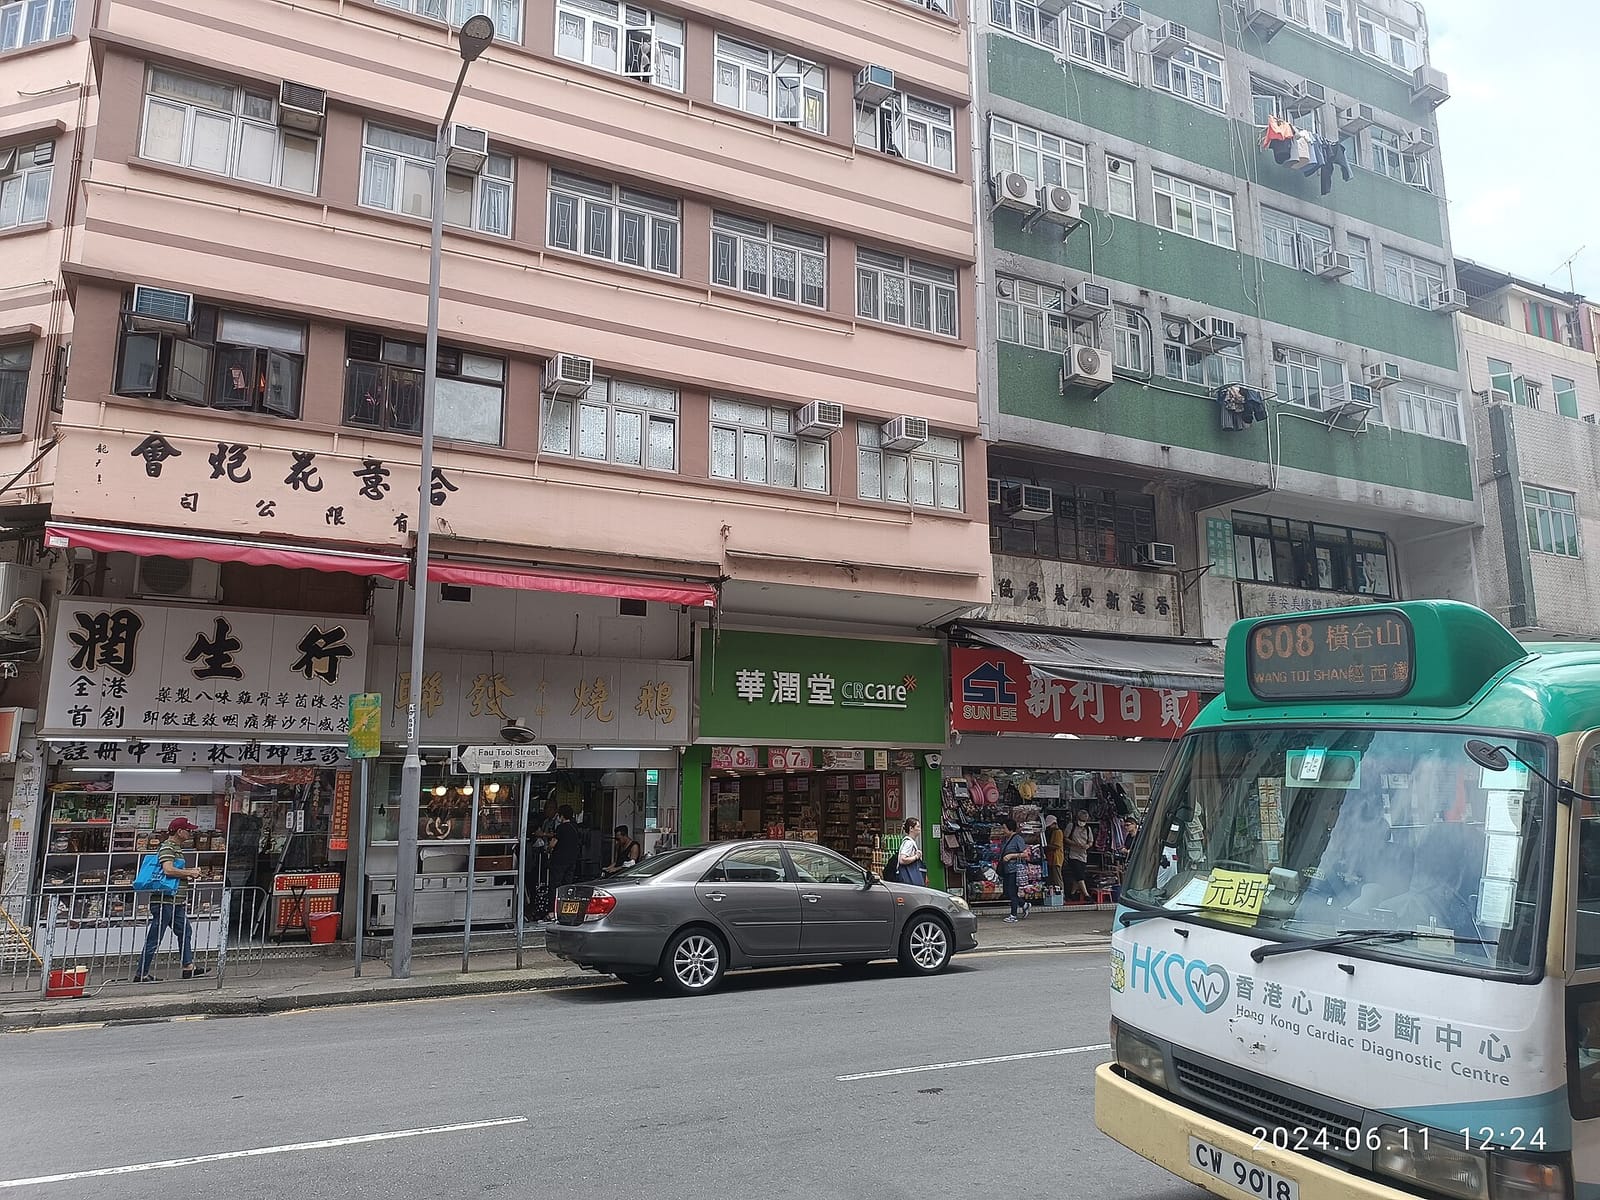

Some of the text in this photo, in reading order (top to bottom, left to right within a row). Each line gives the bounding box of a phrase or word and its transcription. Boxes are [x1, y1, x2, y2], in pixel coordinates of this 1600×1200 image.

[67, 608, 354, 685] 潤生行
[1255, 623, 1315, 660] 608
[1326, 620, 1401, 652] 橫台山
[69, 675, 129, 699] 全港
[735, 668, 907, 705] 華潤堂 CRcare
[1254, 671, 1287, 683] WANG
[1292, 670, 1311, 682] TOI
[1313, 668, 1350, 682] SHAN
[67, 704, 125, 728] 首創
[963, 705, 1018, 721] SUN LEE
[478, 748, 539, 756] Fau Tsoi Street
[1206, 878, 1262, 909] 元朗
[1236, 974, 1511, 1063] 香港心臟診斷中心
[1236, 1004, 1510, 1086] Hong Kong Cardiac Diagnostic Centre
[1196, 1143, 1291, 1200] CW 9018
